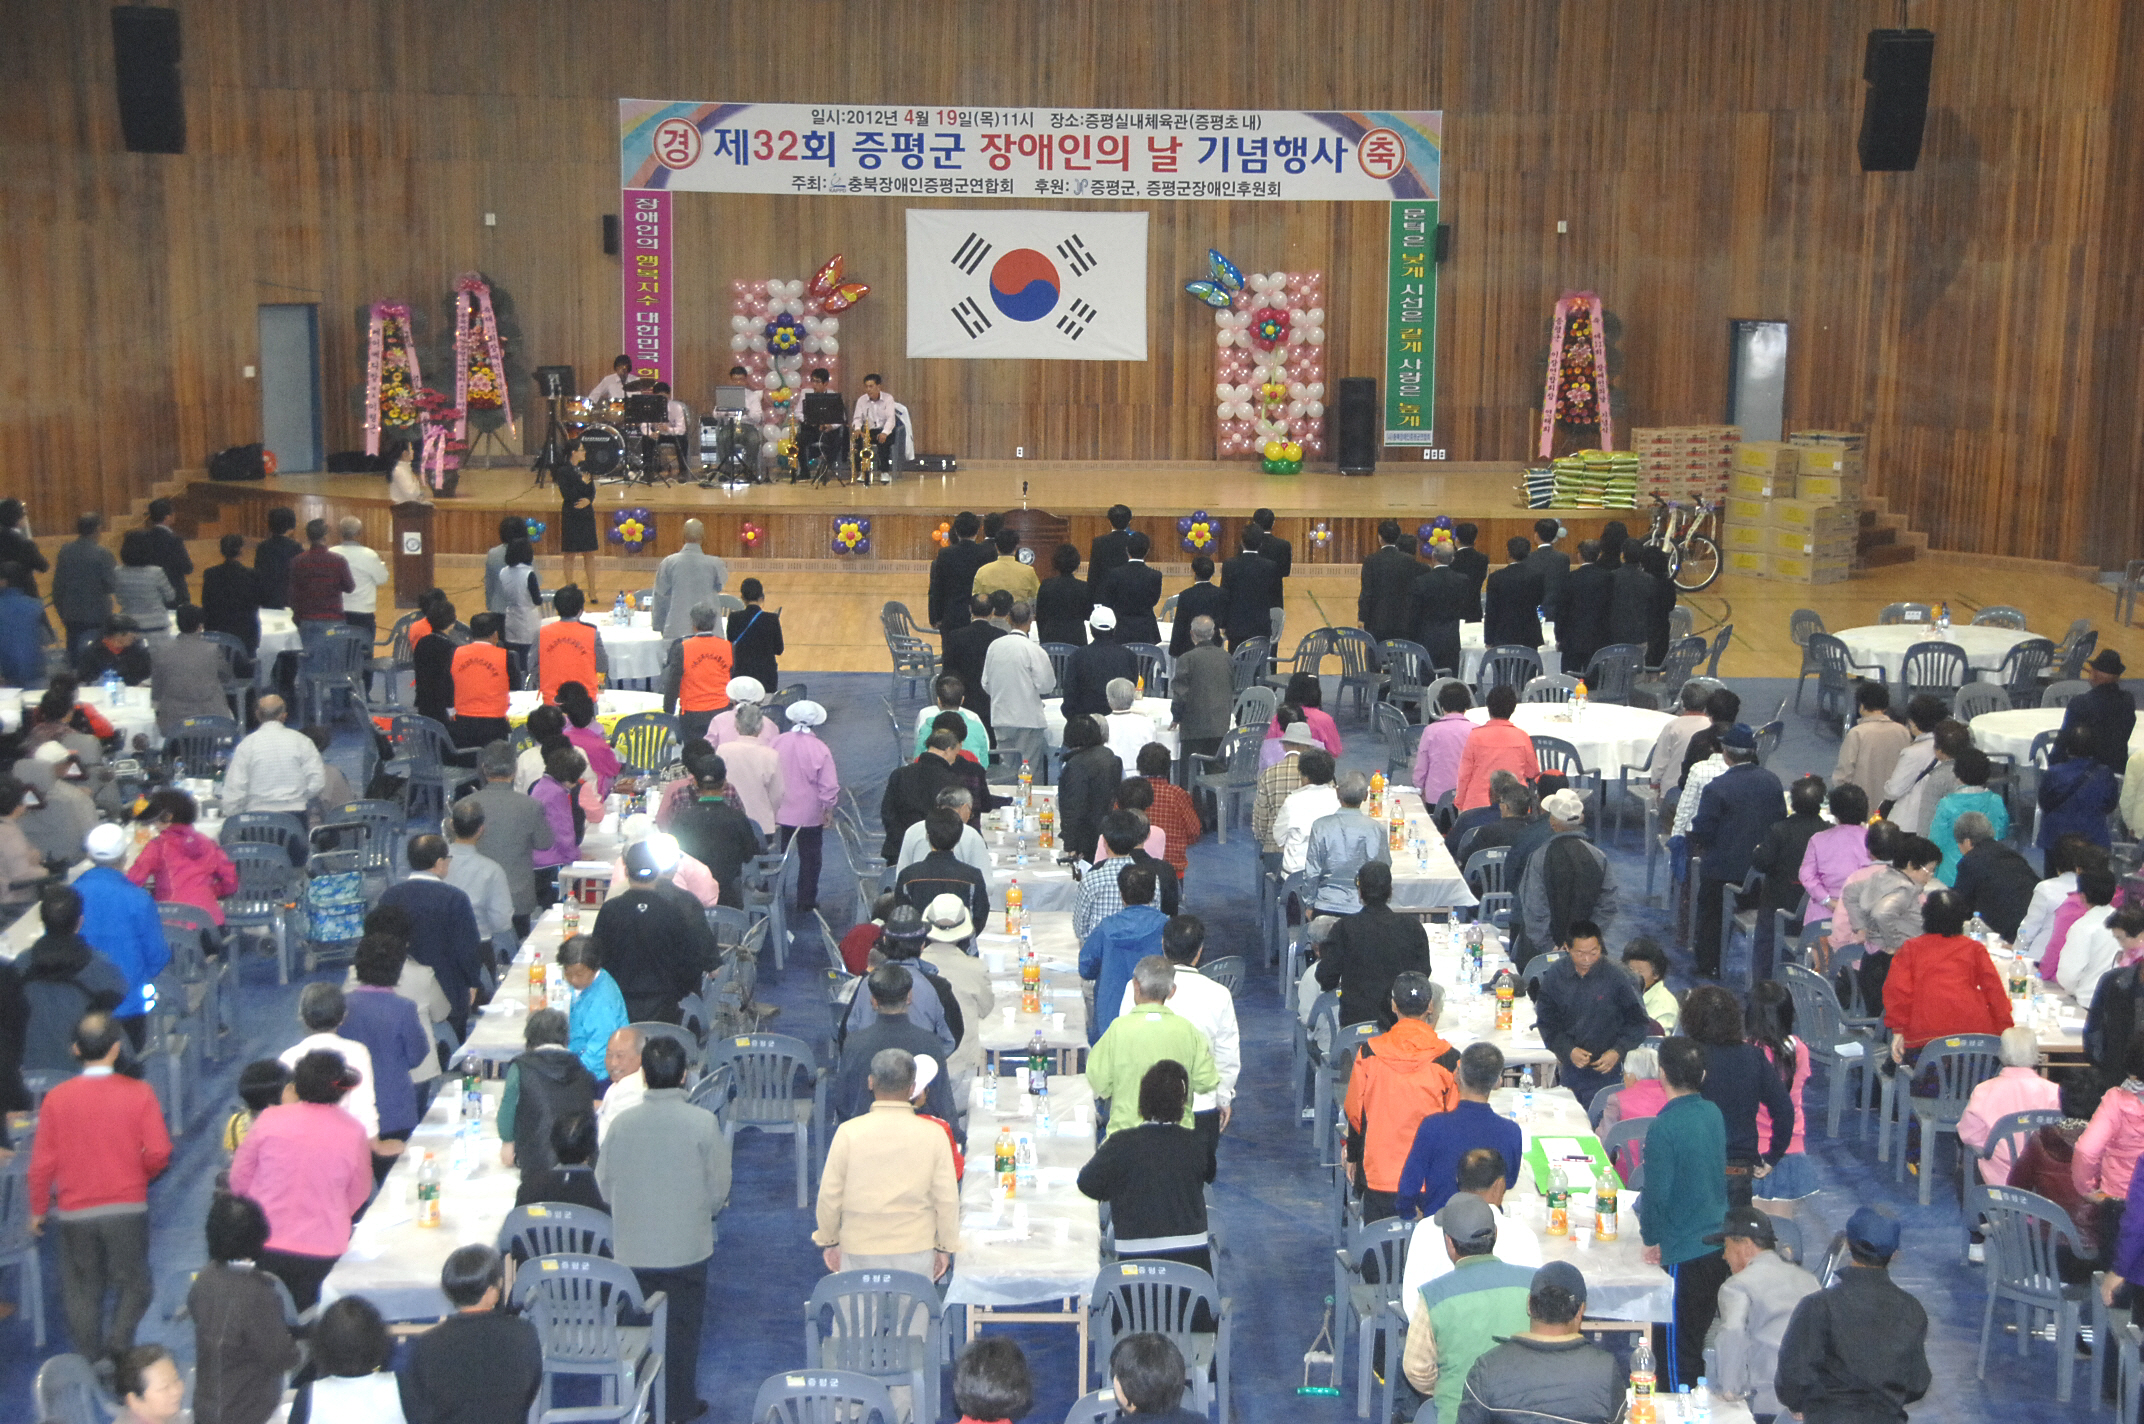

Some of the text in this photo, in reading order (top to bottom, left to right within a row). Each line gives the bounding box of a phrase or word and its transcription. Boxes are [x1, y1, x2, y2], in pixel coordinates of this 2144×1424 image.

[812, 109, 898, 126] 일시:2012년
[904, 110, 929, 126] 4월
[662, 128, 690, 161] 경
[714, 129, 1348, 173] 제32회 증평군 장애인의 날 기념행사
[1366, 135, 1396, 170] 축
[792, 176, 826, 191] 주최:
[1035, 179, 1069, 195] 후원:
[1147, 181, 1281, 197] 증평군장애인후원회
[635, 198, 660, 250] 장애인의
[636, 255, 660, 306] 행복지수
[636, 312, 660, 363] 대한민국
[1397, 208, 1426, 427] 문턱은 낮게 시선은 같게 사랑은 높게
